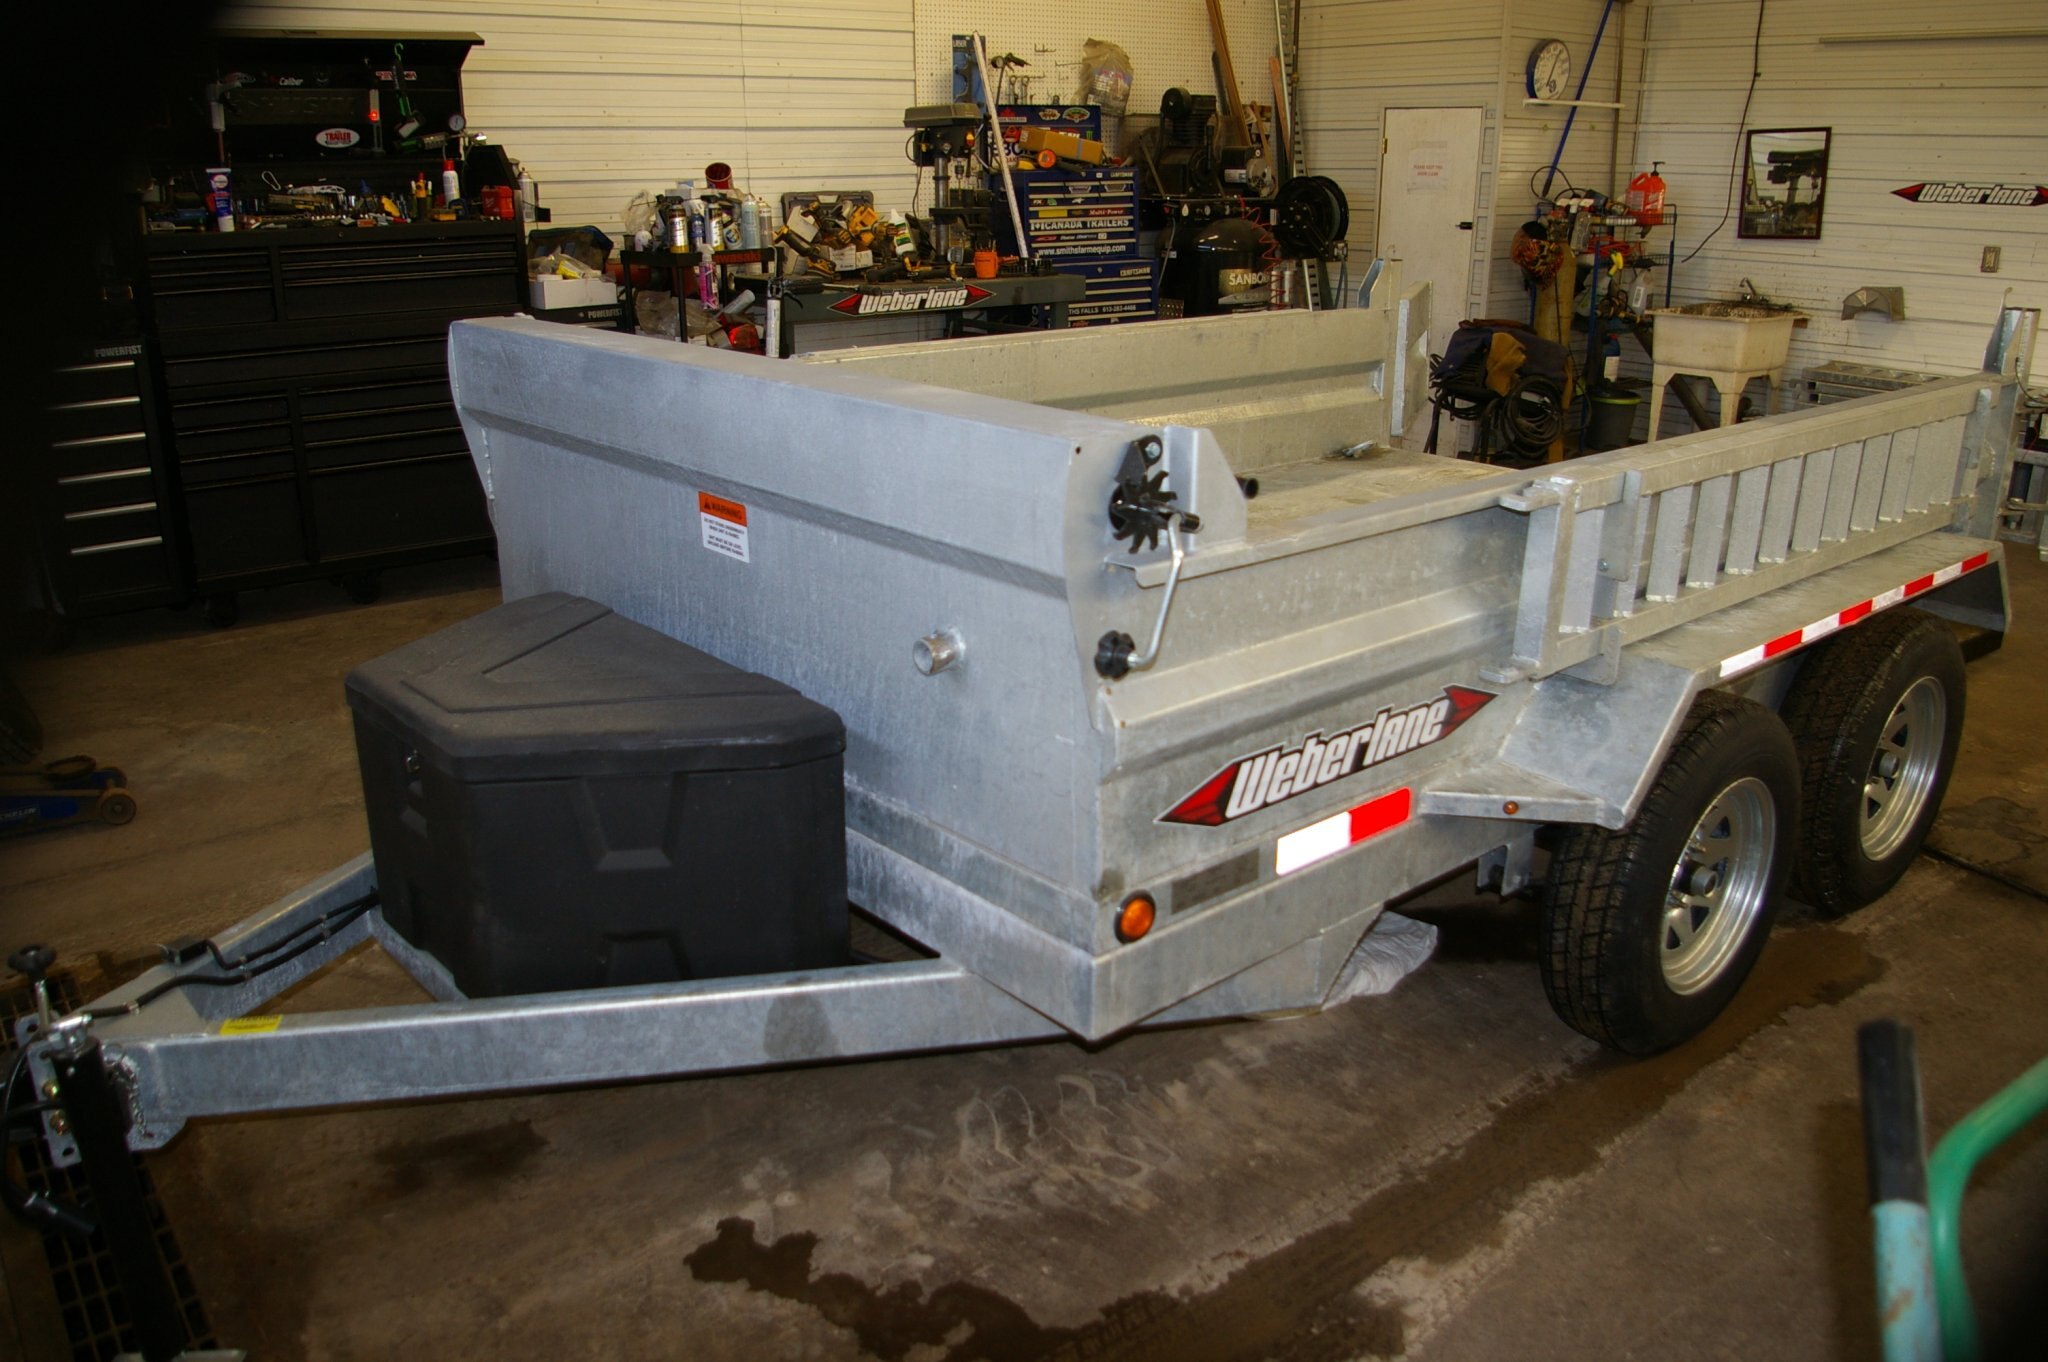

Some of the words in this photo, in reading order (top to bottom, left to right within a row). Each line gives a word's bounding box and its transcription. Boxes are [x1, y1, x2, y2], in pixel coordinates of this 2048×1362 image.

[325, 132, 352, 141] TRAILER
[1045, 221, 1083, 230] CANADA
[1087, 219, 1129, 228] TRAILERS
[1038, 245, 1126, 256] www.smithsfarmequip.com
[712, 250, 762, 264] awasaki
[1228, 271, 1269, 286] SANBO
[1081, 306, 1099, 314] FALLS
[1225, 697, 1450, 819] Weberlane
